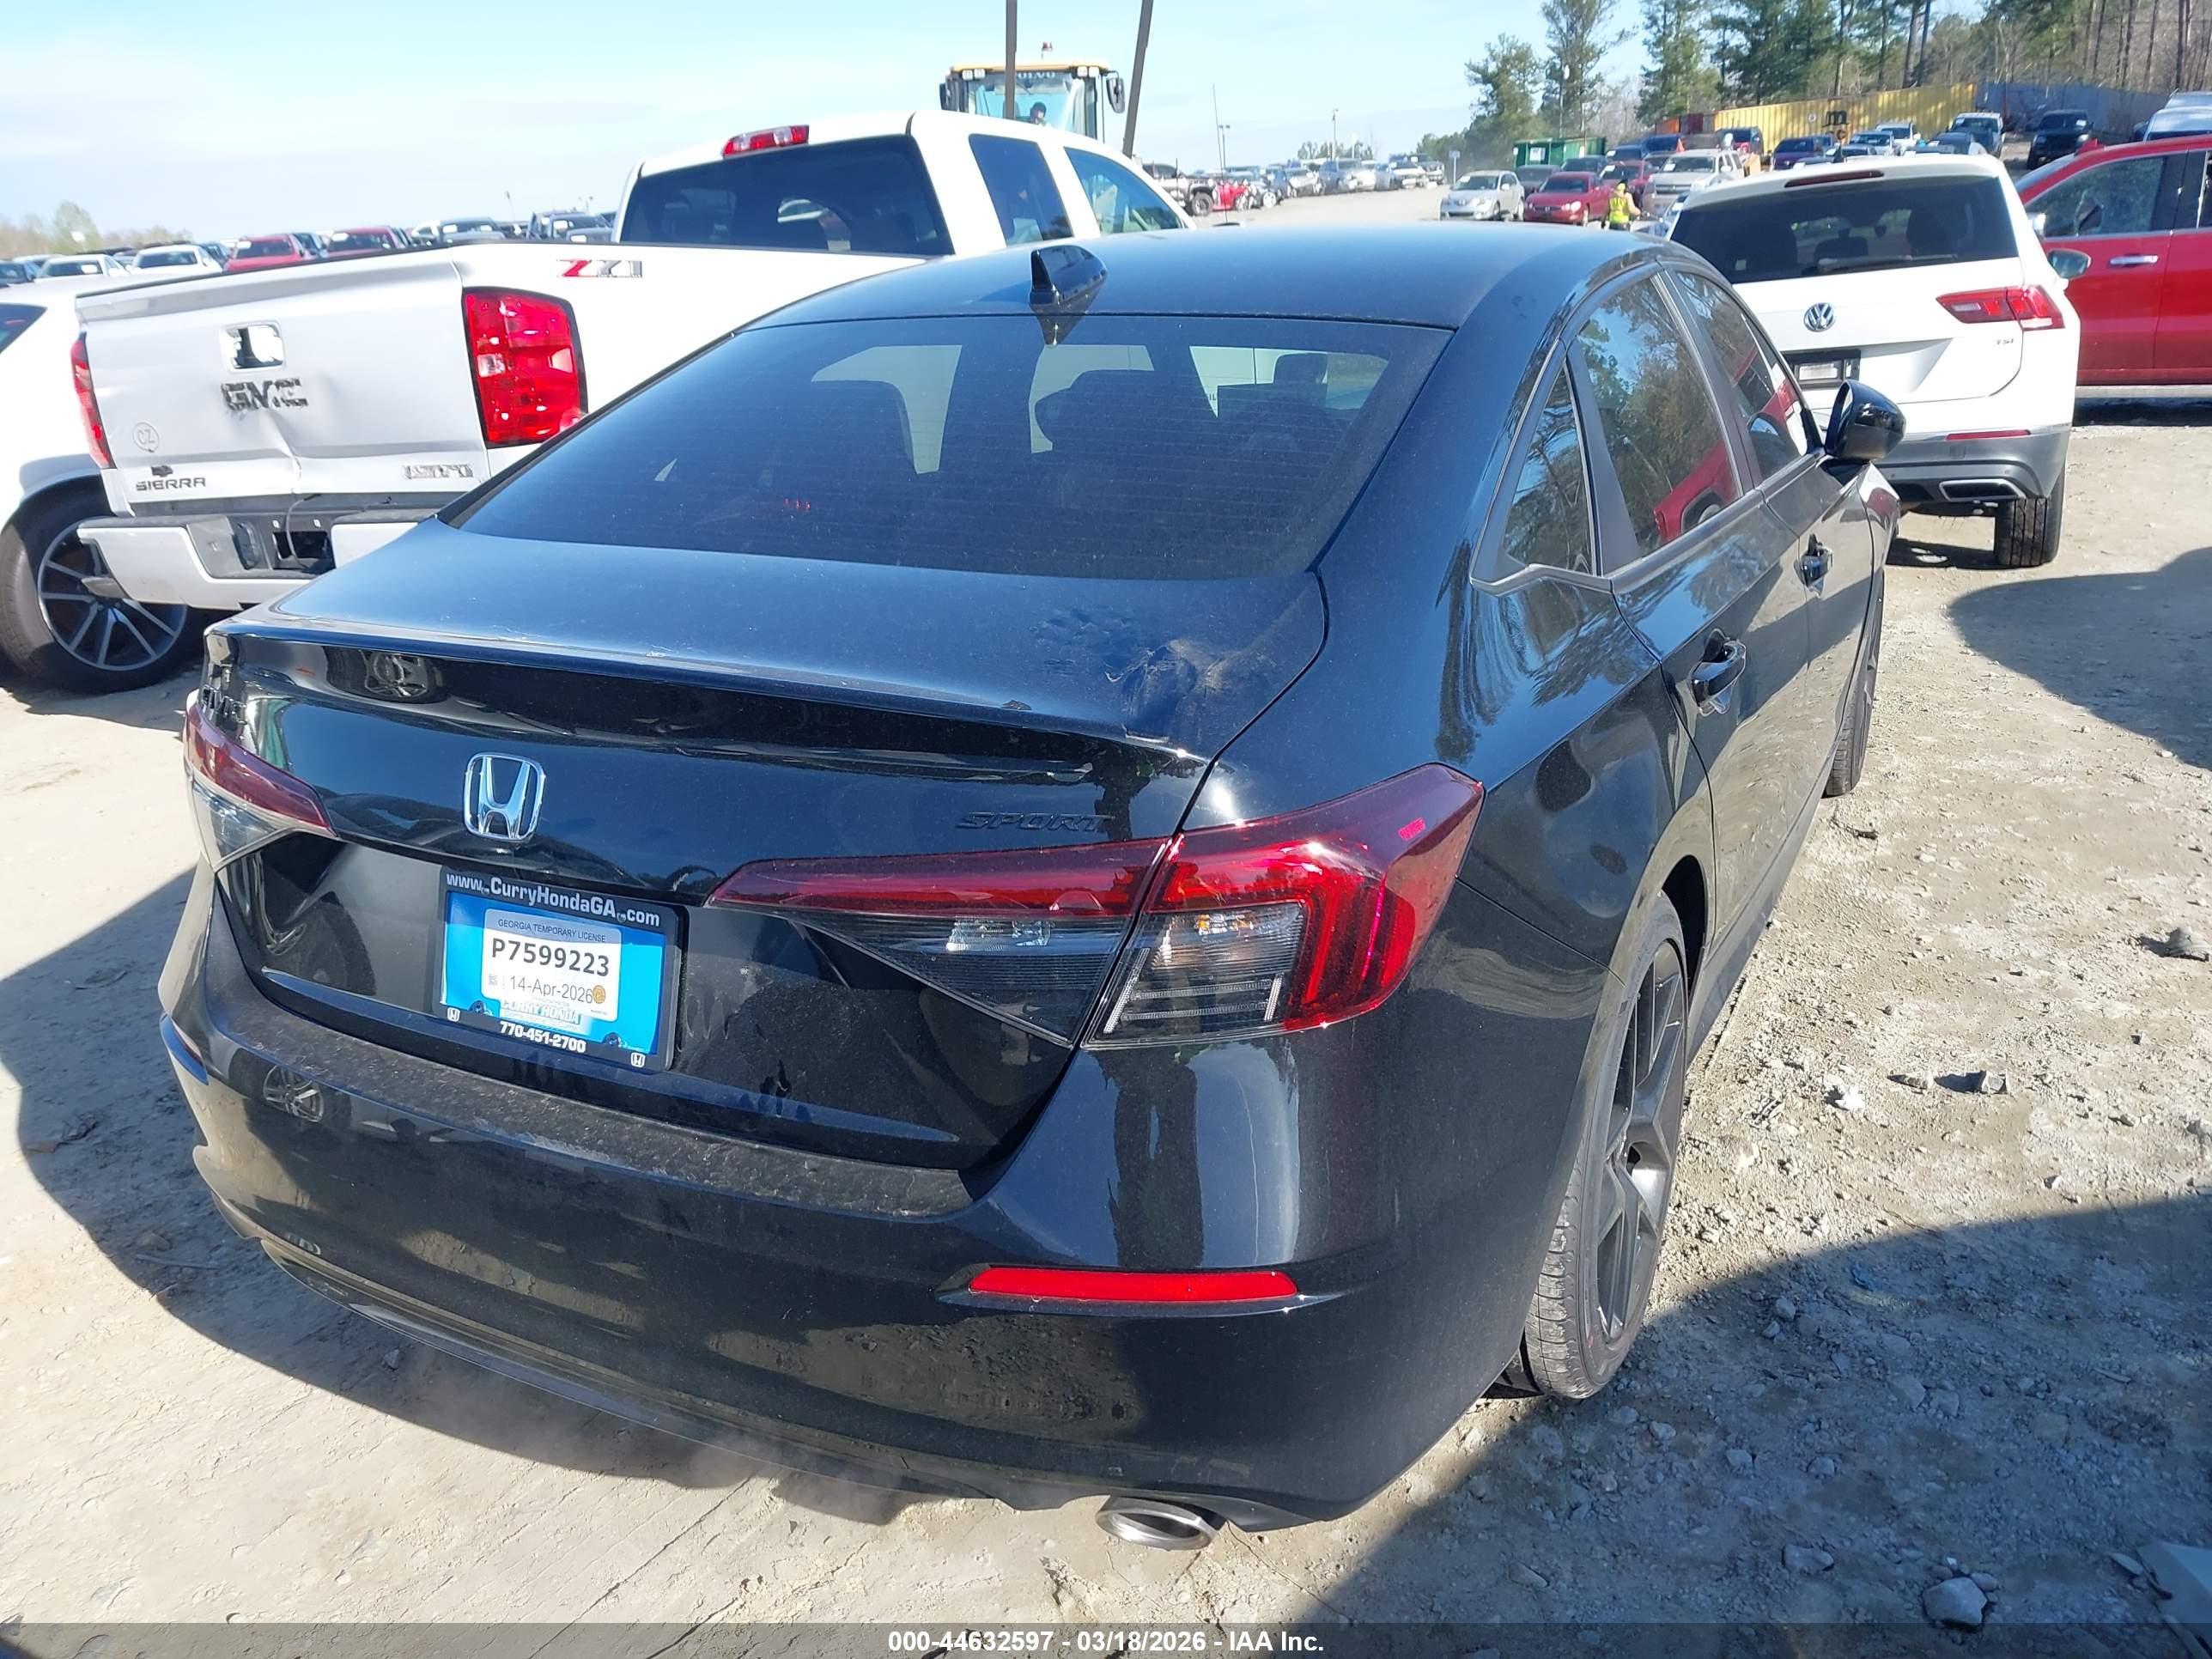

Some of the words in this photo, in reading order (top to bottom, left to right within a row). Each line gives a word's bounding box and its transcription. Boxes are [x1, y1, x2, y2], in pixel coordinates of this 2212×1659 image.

[556, 258, 643, 278] Z71
[136, 477, 206, 491] SIERRA
[956, 811, 1115, 833] SPORT
[446, 873, 660, 927] www.CurryHondaGA.com
[498, 919, 532, 932] GEORGIA
[533, 923, 577, 939] TEMPORARY
[578, 930, 606, 943] LICENSE
[492, 937, 610, 977] P7599223
[509, 975, 592, 1005] 14-Apr-2026
[500, 1020, 586, 1053] 770-451-2700
